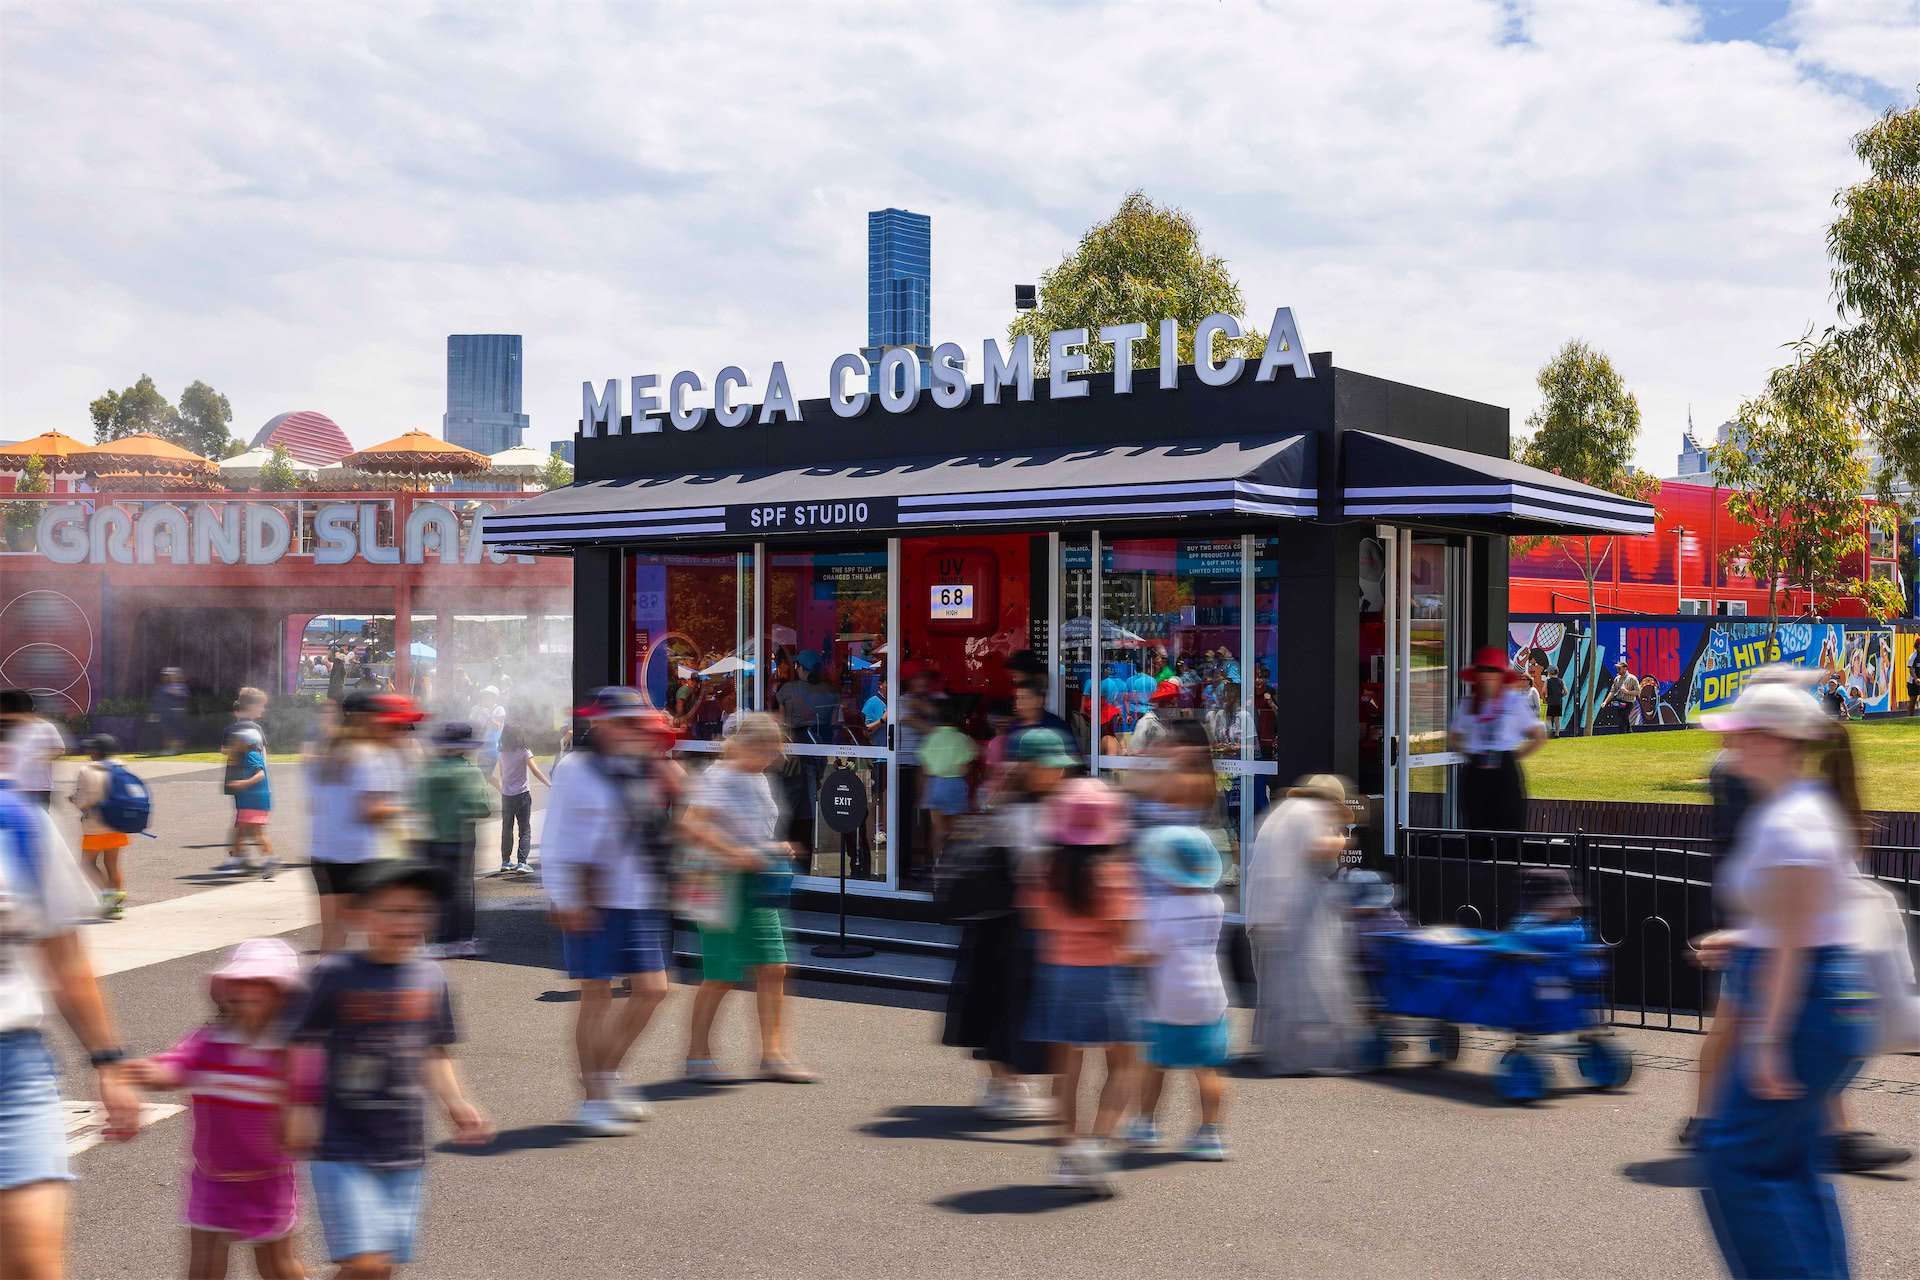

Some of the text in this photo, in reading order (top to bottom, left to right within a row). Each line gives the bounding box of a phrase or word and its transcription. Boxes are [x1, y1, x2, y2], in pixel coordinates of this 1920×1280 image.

[583, 306, 1316, 438] MECCA COSMETICA
[750, 502, 868, 528] SPF STUDIO
[36, 504, 291, 564] GRAND
[939, 558, 965, 576] UV
[938, 576, 965, 586] INDEX
[941, 588, 963, 606] 6.8
[1627, 627, 1680, 683] STARS
[1733, 638, 1782, 670] HITS
[834, 797, 853, 806] EXIT
[1340, 855, 1363, 864] BODY
